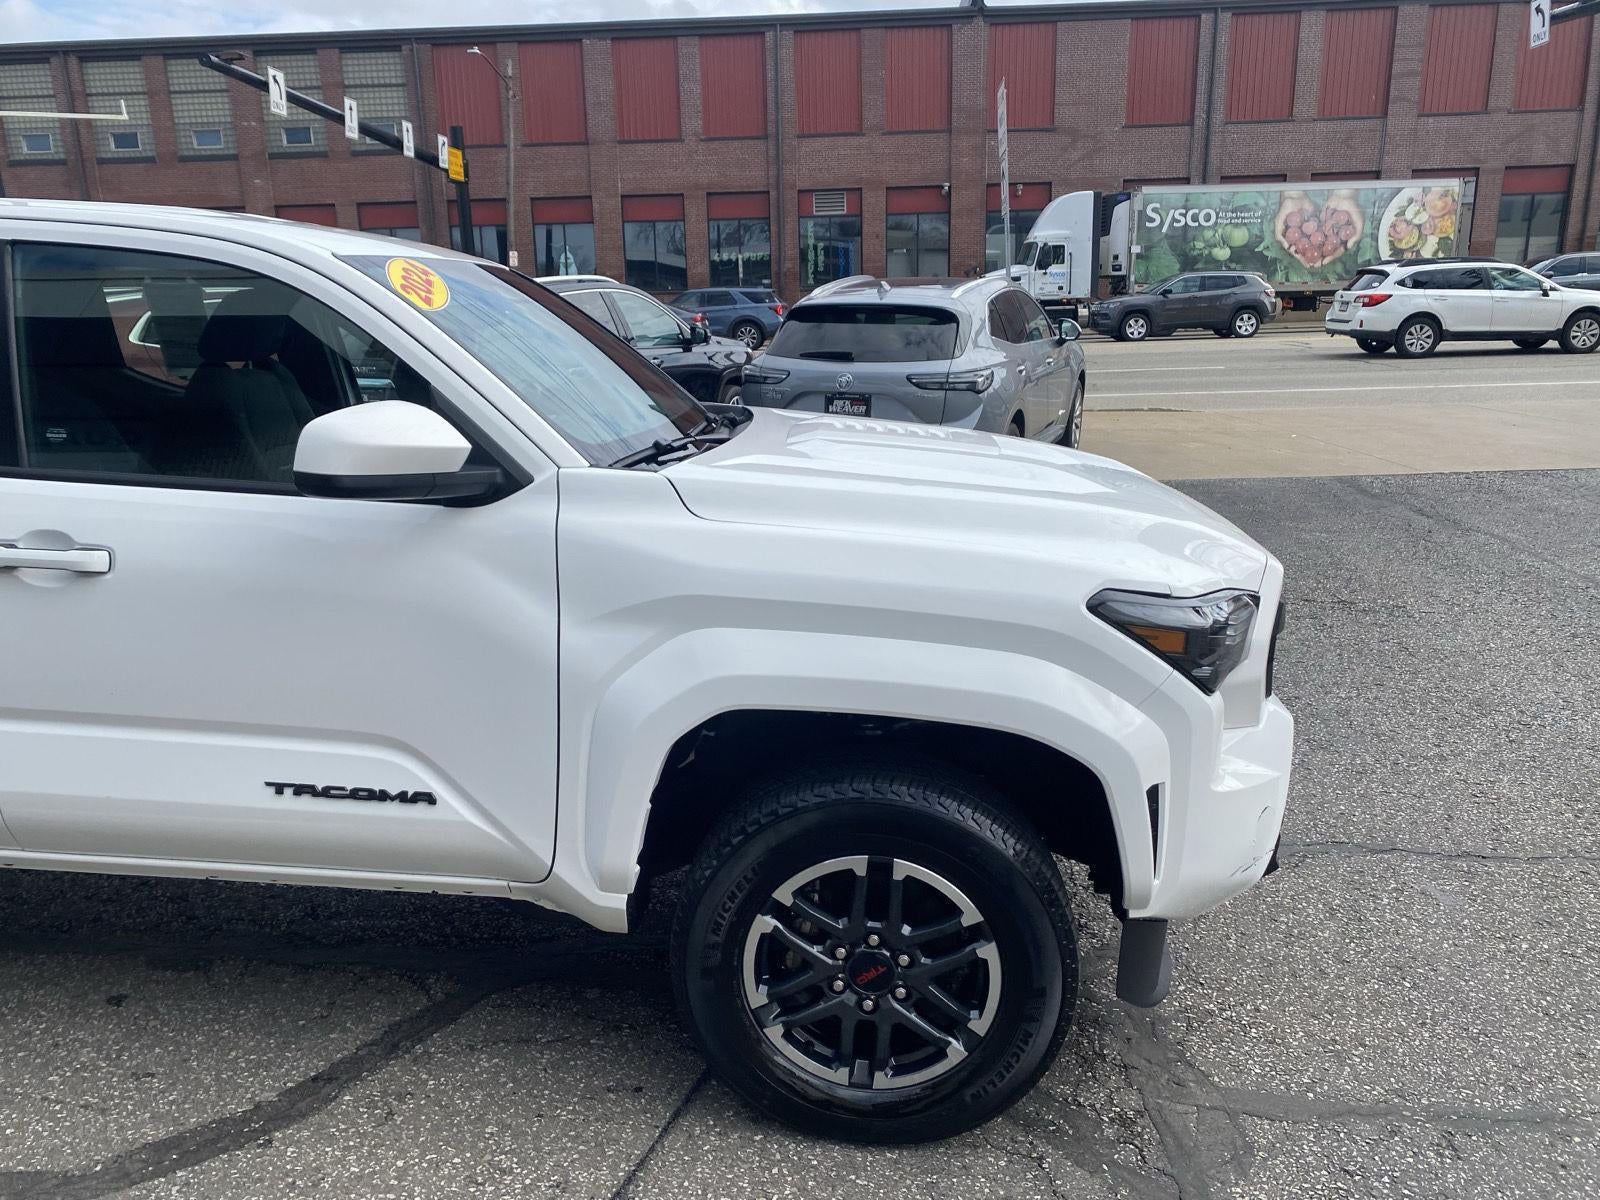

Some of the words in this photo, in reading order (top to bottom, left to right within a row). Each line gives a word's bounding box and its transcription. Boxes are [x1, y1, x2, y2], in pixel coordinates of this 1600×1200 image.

[1533, 31, 1546, 43] ONLY
[1255, 210, 1262, 218] of
[400, 259, 435, 308] 2024
[829, 405, 867, 413] WEAVER
[264, 781, 437, 805] TACOMA
[711, 864, 761, 937] MICHELI
[969, 1028, 1034, 1099] MICHELIN
